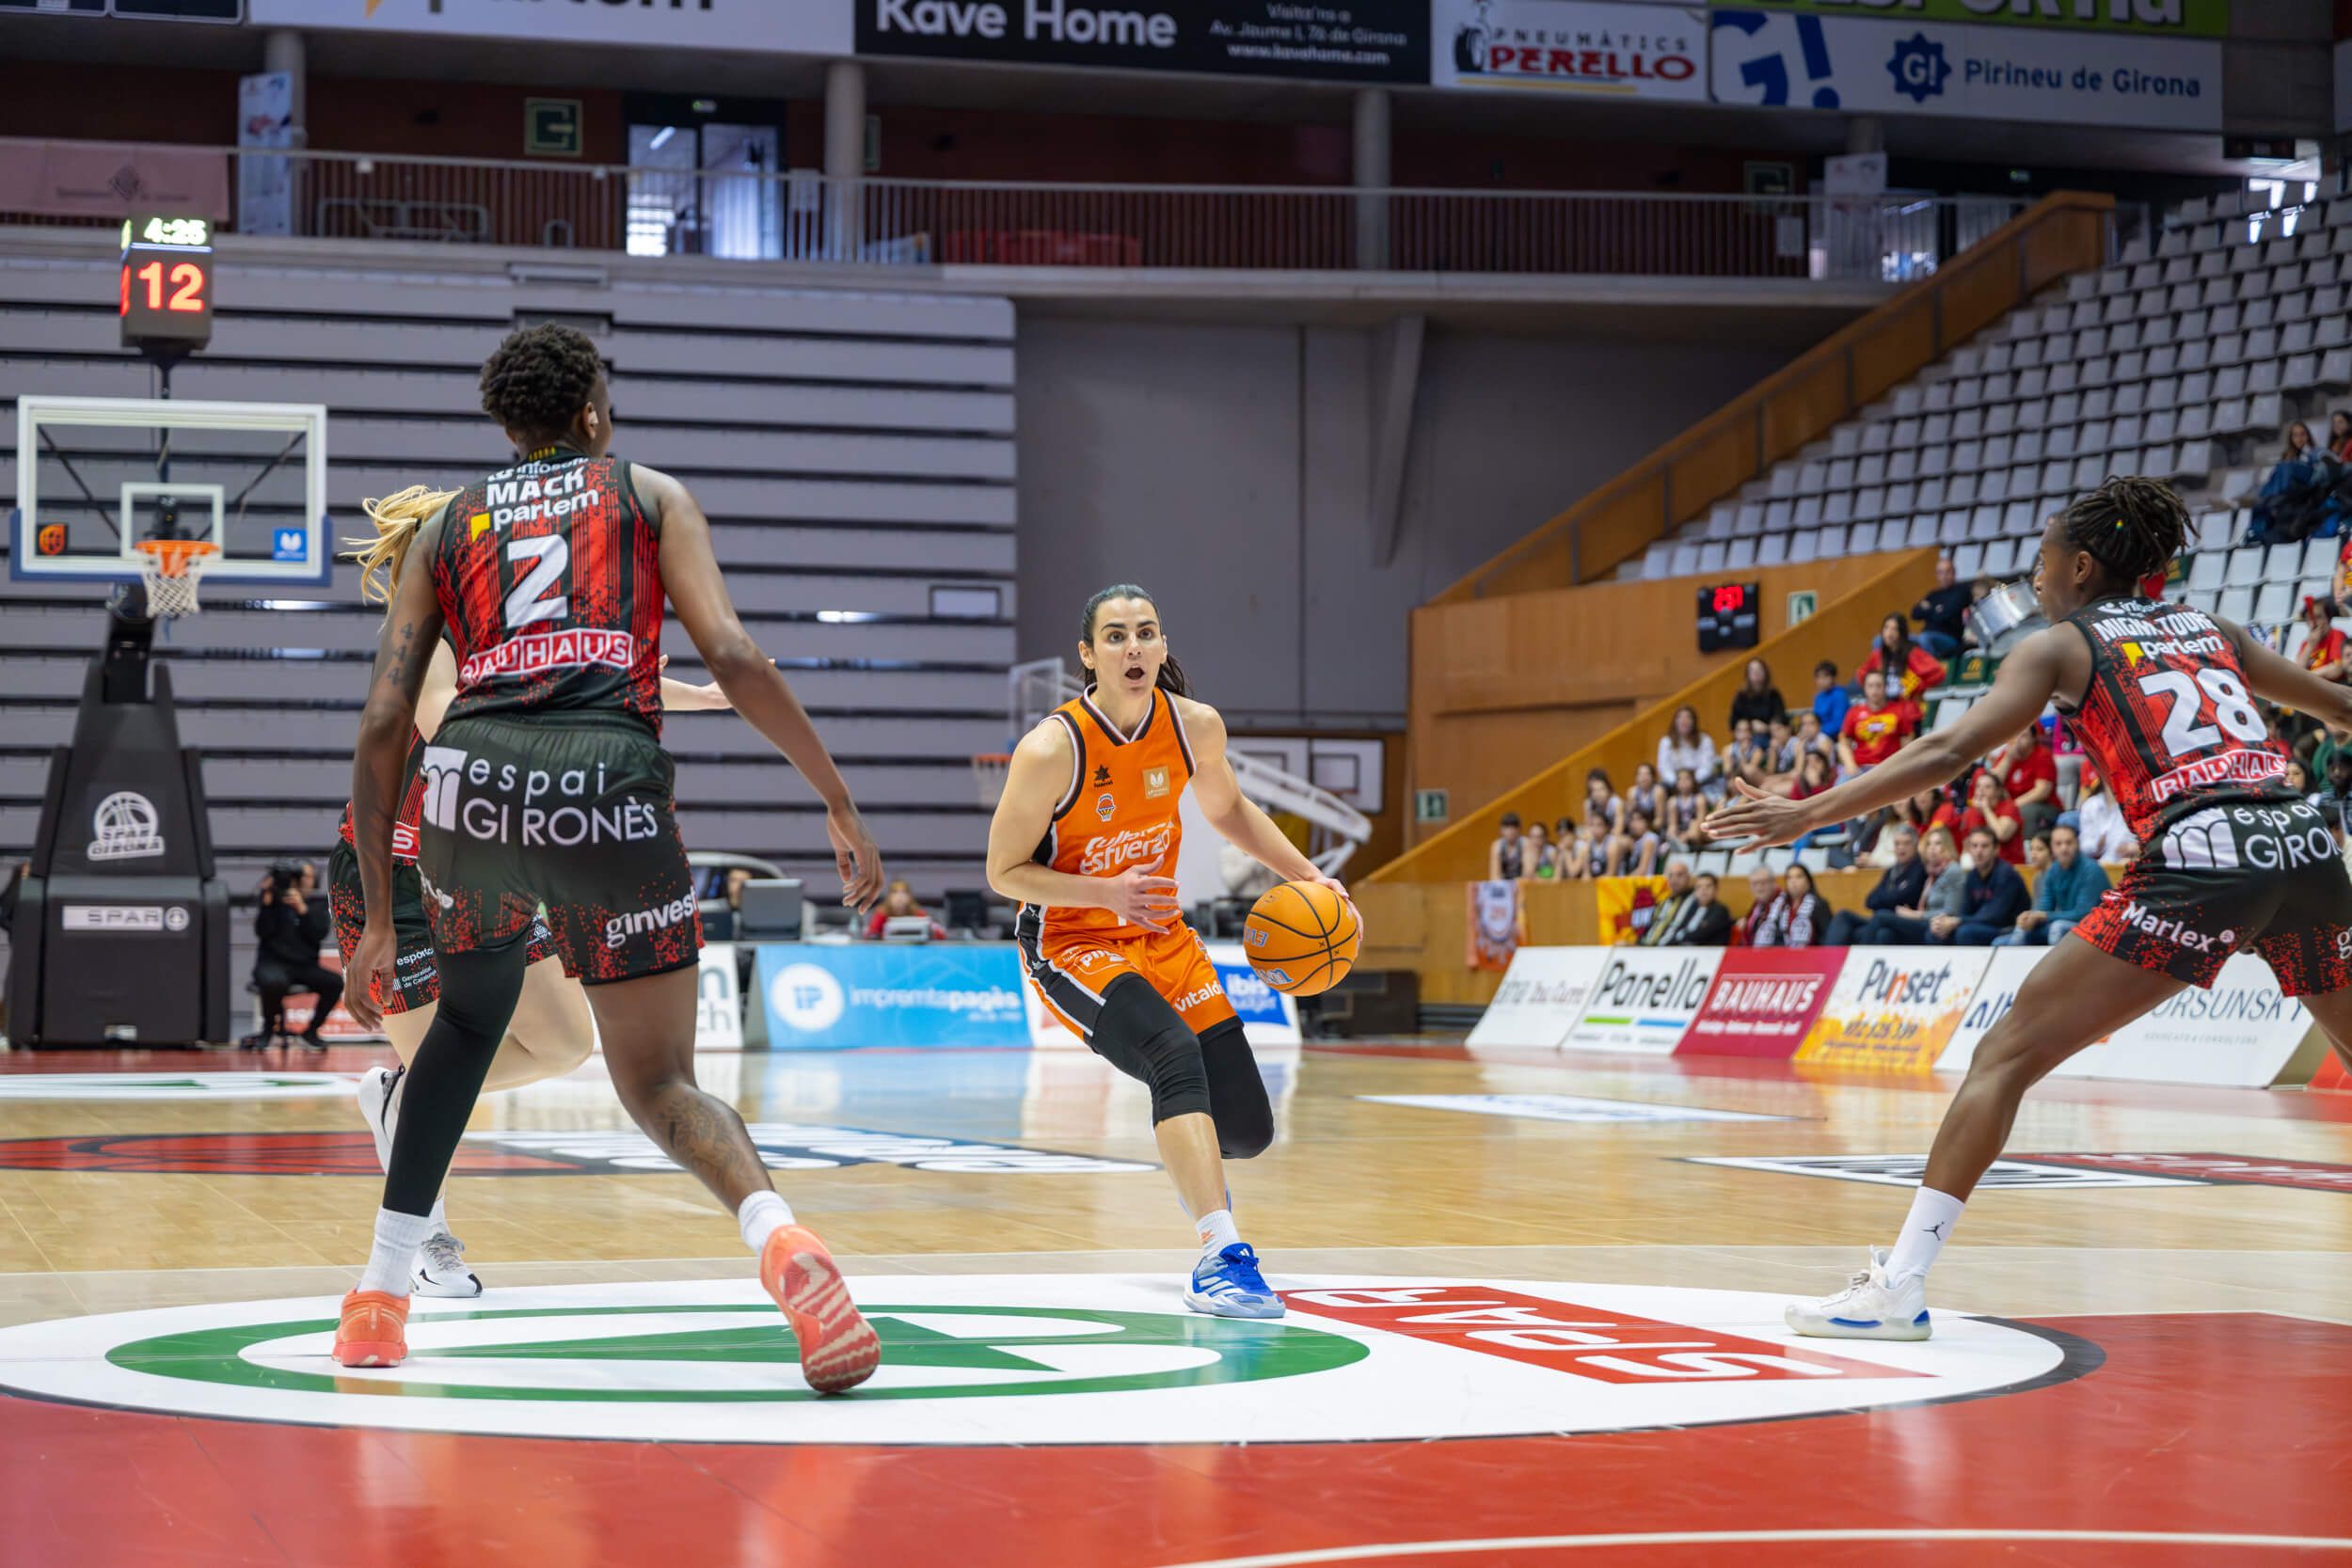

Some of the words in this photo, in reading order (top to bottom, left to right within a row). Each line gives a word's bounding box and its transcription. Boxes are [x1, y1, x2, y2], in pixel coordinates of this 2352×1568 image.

[876, 0, 1007, 38] Kave
[1025, 0, 1178, 47] Home
[1239, 22, 1293, 40] Jaume
[1352, 27, 1408, 46] Girona
[1227, 42, 1391, 66] www.kavehome.com
[1963, 58, 2062, 90] Pirineu
[2072, 64, 2103, 93] de
[2112, 68, 2201, 98] Girona
[138, 261, 205, 312] 12
[486, 466, 585, 508] MACK
[493, 488, 599, 532] parlem
[504, 533, 569, 629] 2
[2140, 635, 2225, 660] parlem
[2137, 666, 2268, 759] 28
[469, 757, 606, 806] espai
[462, 796, 660, 846] GIRONÈS
[2244, 827, 2344, 871] GIRON
[87, 911, 159, 924] SPAR
[2122, 900, 2216, 953] Marlex
[1592, 958, 1710, 1010] Panella
[1709, 979, 1821, 1013] BAUHAUS
[1857, 958, 1953, 1006] Punset
[1286, 1288, 1845, 1378] SPAR
